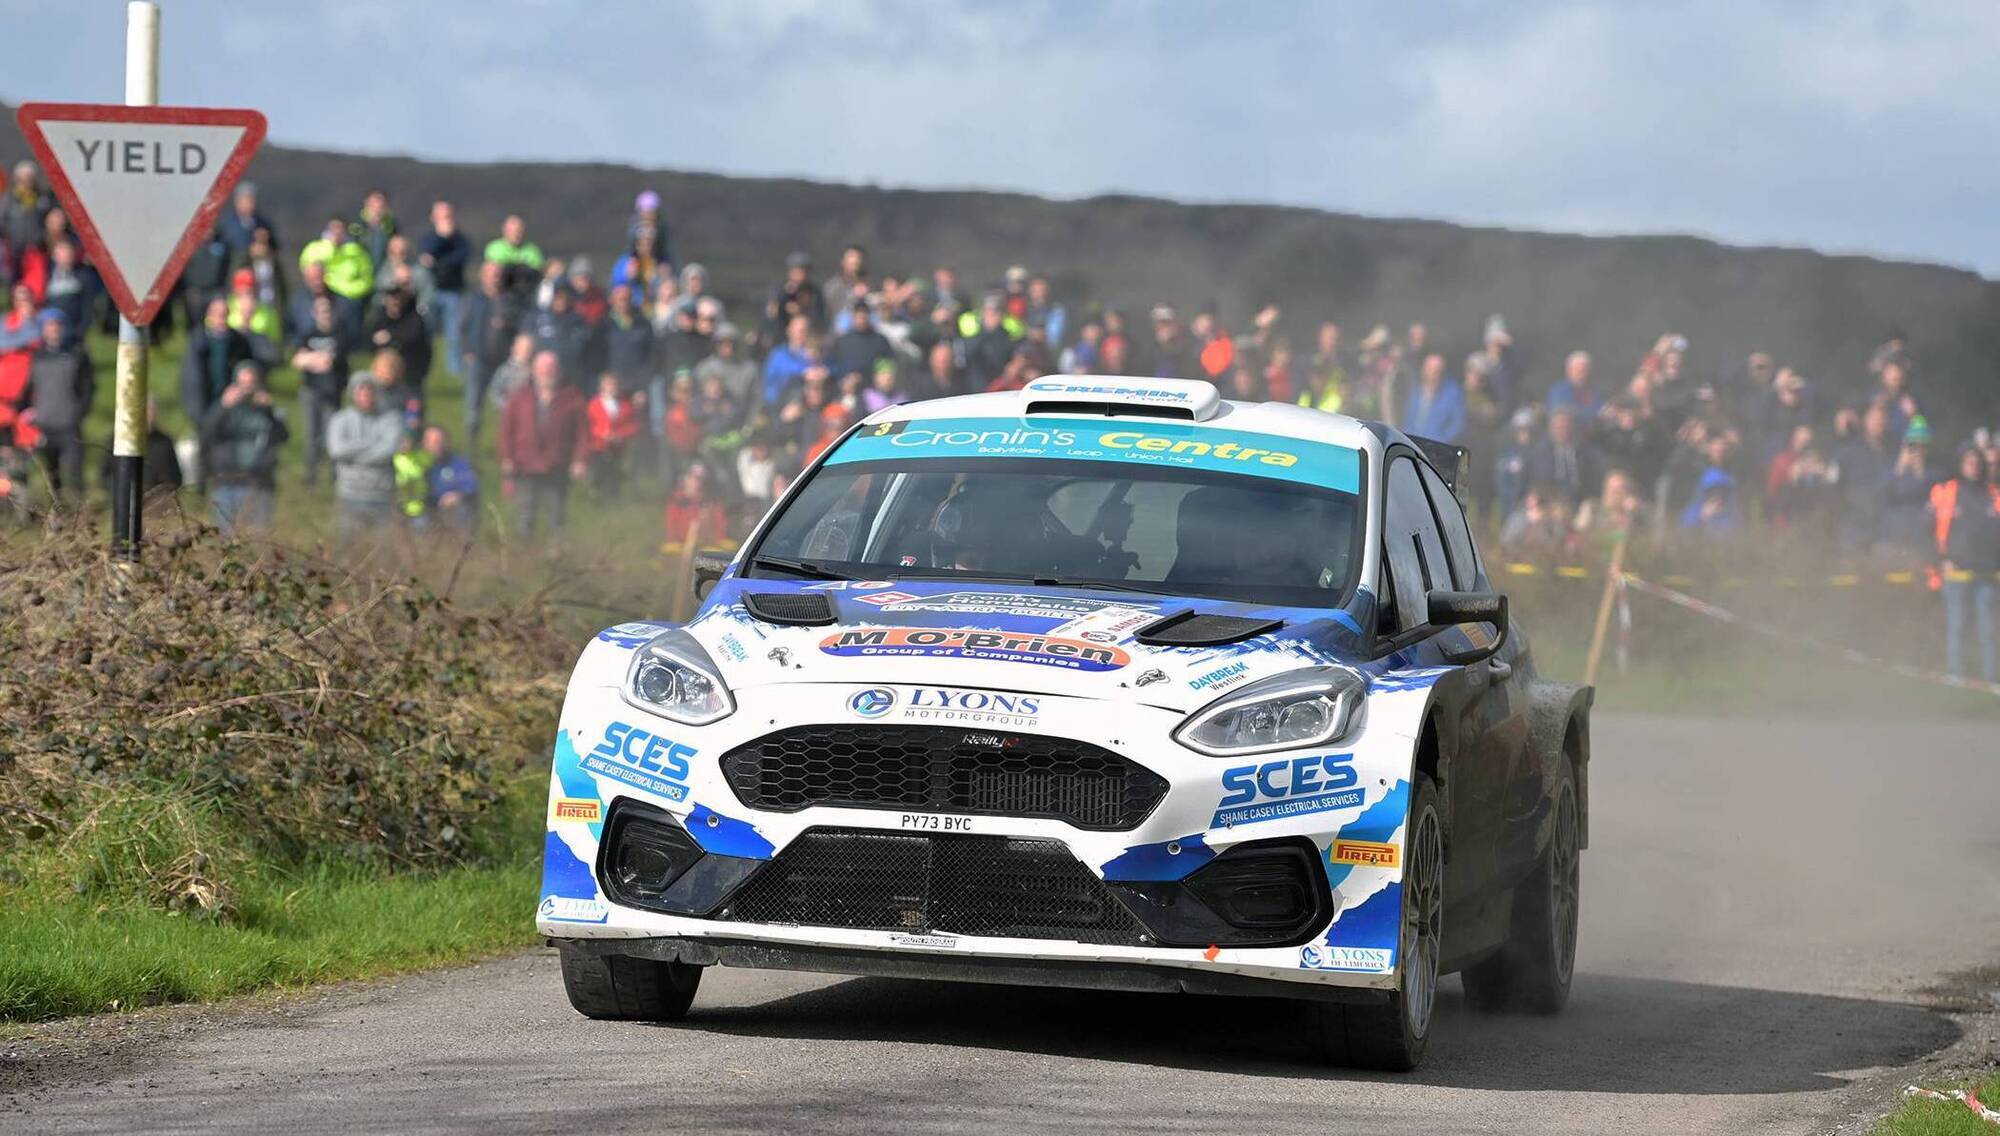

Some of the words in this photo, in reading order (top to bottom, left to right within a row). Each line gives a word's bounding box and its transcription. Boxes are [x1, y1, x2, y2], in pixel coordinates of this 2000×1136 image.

[75, 139, 207, 175] YIELD
[1029, 383, 1188, 400] CREMIN
[874, 422, 893, 436] 3
[890, 428, 1076, 447] Cronin's
[1098, 431, 1299, 467] Centra
[1125, 451, 1164, 461] Union
[946, 598, 1090, 611] Homevalue
[838, 630, 887, 647] M
[905, 630, 1116, 664] O'Brien
[862, 647, 925, 656] Group
[961, 648, 1080, 668] Companies
[1188, 661, 1250, 690] DAYBREAK
[1209, 673, 1247, 691] Westlink
[910, 688, 1041, 715] LYONS
[904, 710, 1038, 727] MOTORGROUP
[593, 720, 699, 782] SCES
[586, 758, 605, 773] SHANE
[604, 763, 623, 778] CASEY
[623, 768, 653, 789] ELECTRICAL
[652, 779, 683, 799] SERVICES
[1217, 752, 1358, 808] SCES
[556, 802, 598, 818] PIRELLI
[1219, 809, 1249, 824] SHANE
[1249, 805, 1275, 820] CASEY
[1276, 800, 1322, 815] ELECTRICAL
[1321, 793, 1360, 809] SERVICES
[901, 814, 939, 830] PY73
[944, 816, 972, 831] BYC
[1336, 844, 1394, 863] PIRELLI
[1330, 947, 1385, 962] LYONS
